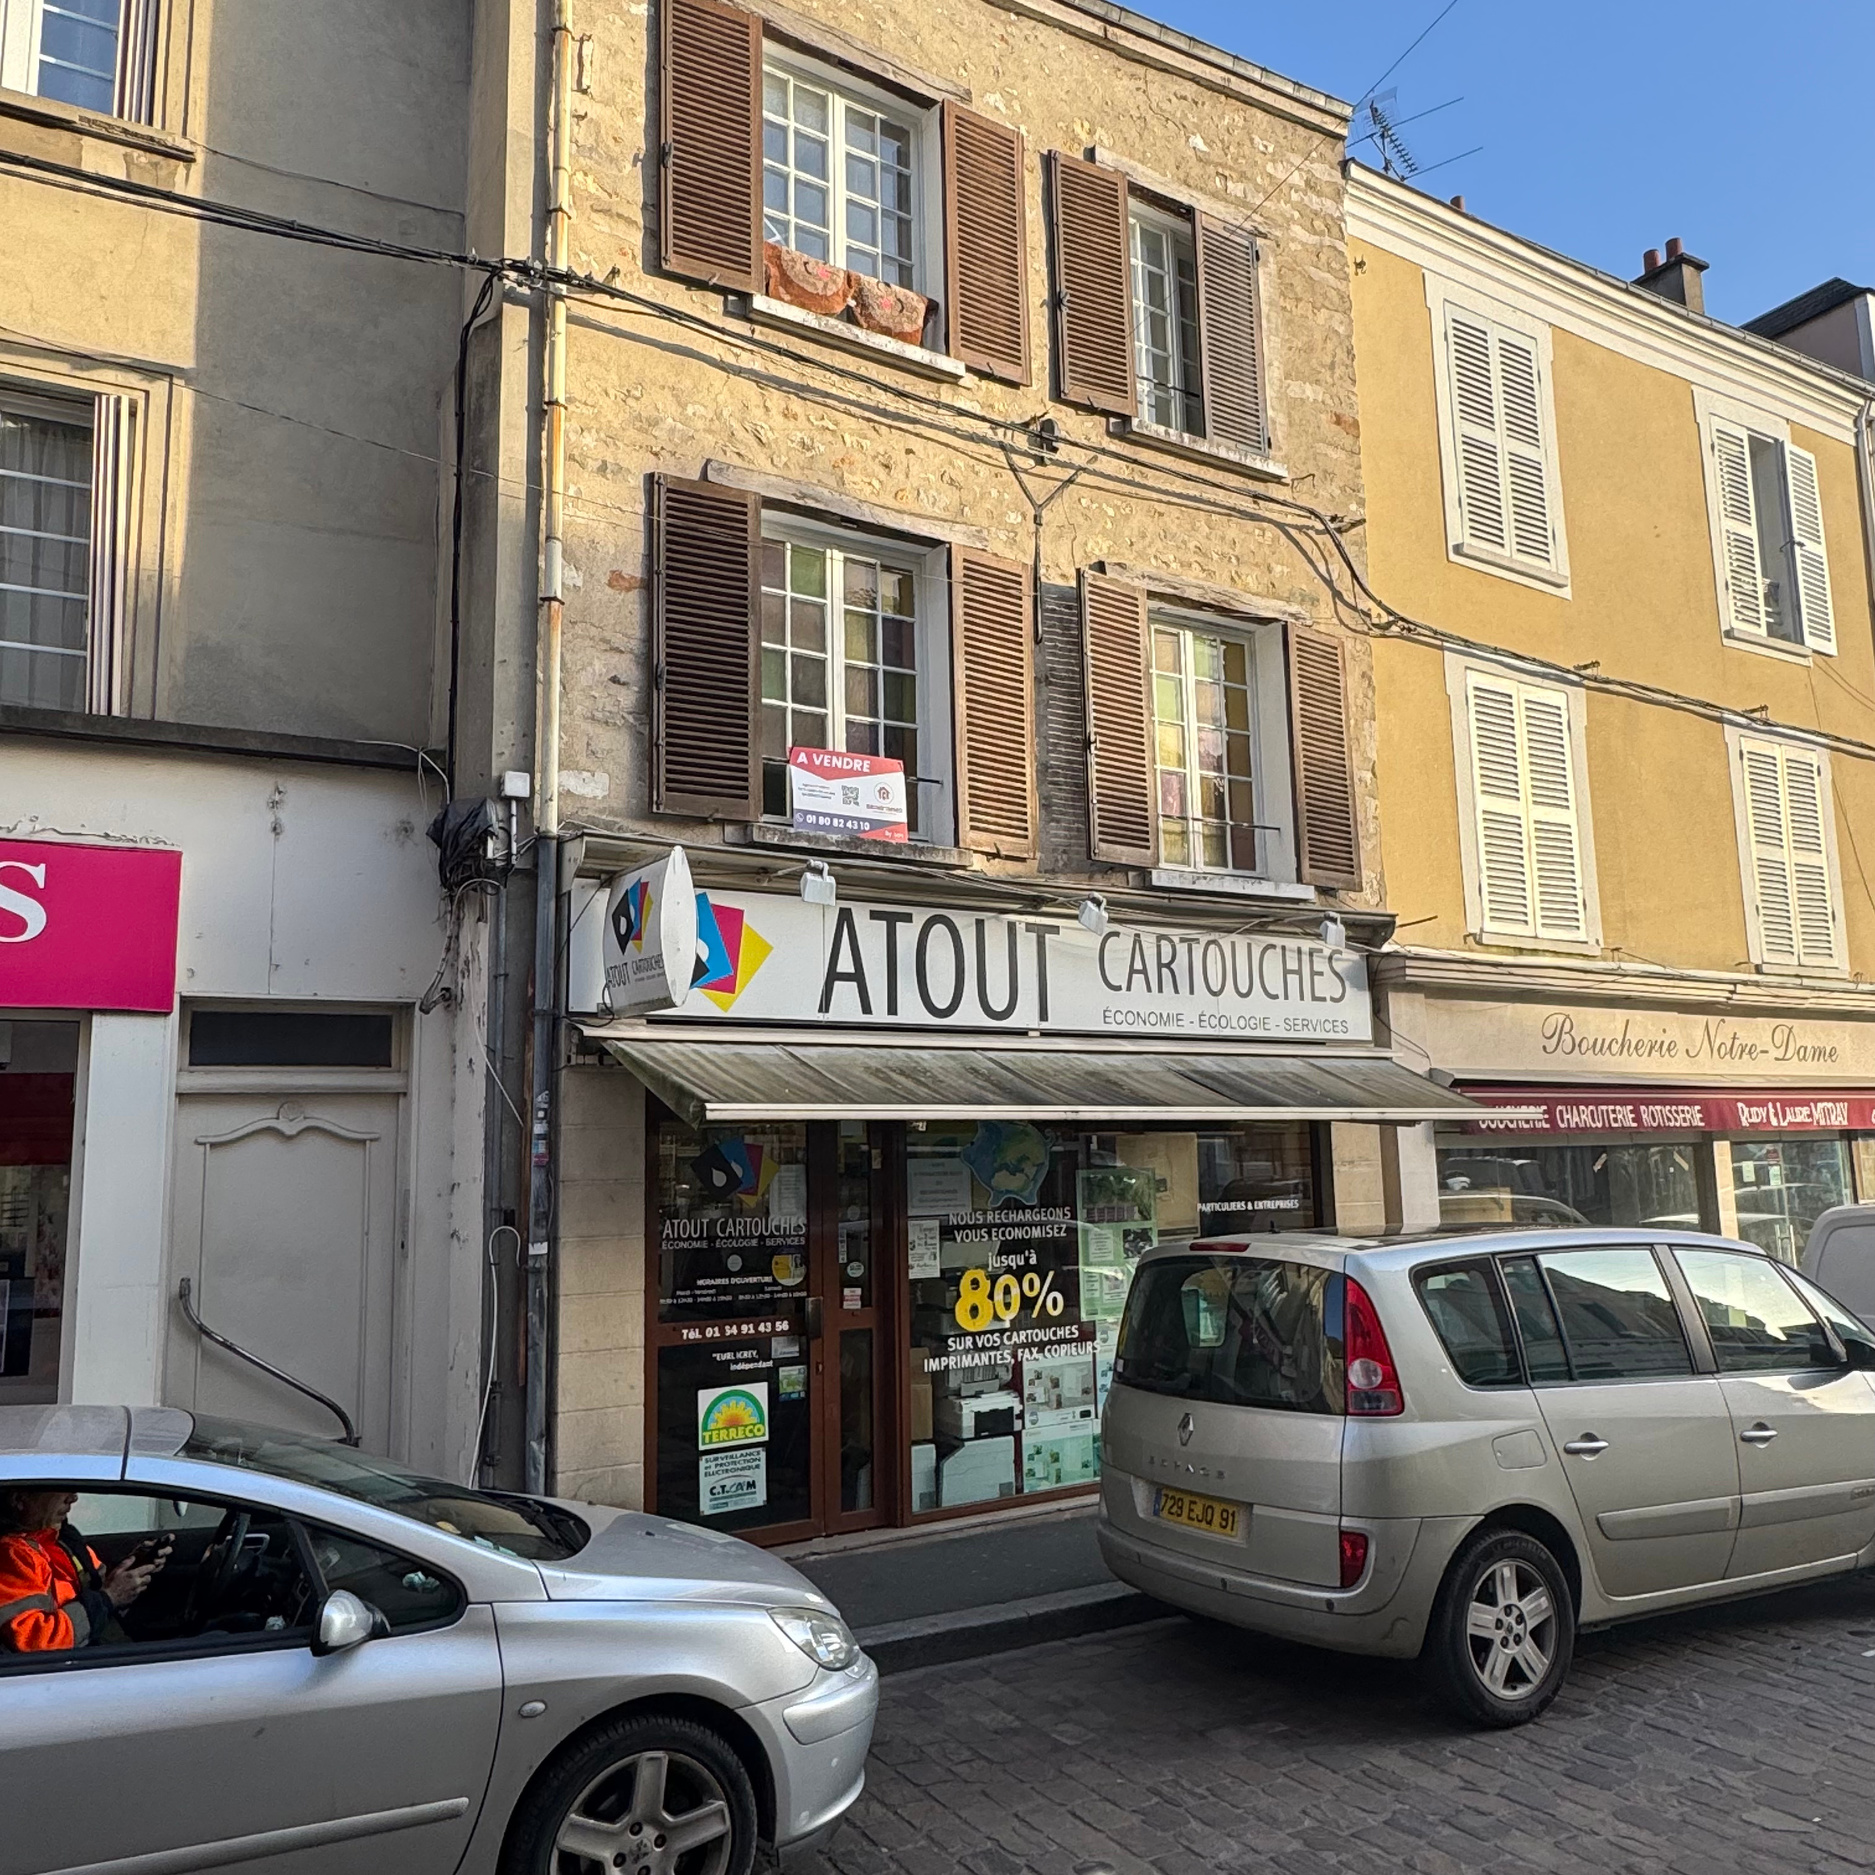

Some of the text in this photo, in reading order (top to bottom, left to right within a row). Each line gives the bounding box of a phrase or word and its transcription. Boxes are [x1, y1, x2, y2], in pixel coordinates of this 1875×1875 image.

[797, 752, 871, 773] A VENDRE
[806, 814, 817, 825] 01
[818, 816, 831, 826] 80
[846, 820, 859, 830] 43
[860, 821, 871, 831] 10
[607, 962, 631, 988] ATOUT
[818, 906, 1060, 1023] ATOUT
[1098, 931, 1347, 1004] CARTOUCHES
[1102, 1006, 1185, 1029] ÉCONOMIE
[1199, 1010, 1271, 1031] ÉCOLOGIE
[1283, 1017, 1349, 1035] SERVICES
[1541, 1012, 1839, 1063] Boucherie Notre-Dame
[1556, 1105, 1638, 1128] CHARCUTERIE
[1640, 1105, 1705, 1127] ROTISSERIE
[950, 1207, 1071, 1225] NOUS RECHARGEONS
[663, 1217, 806, 1239] ATOUT CARTOUCHES
[954, 1224, 1067, 1243] VOUS ECONOMISEZ
[716, 1237, 758, 1248] ÉCOLOGIE
[988, 1250, 1037, 1271] jusqu'à
[955, 1268, 1064, 1332] 80%
[705, 1326, 720, 1337] 01
[741, 1323, 755, 1334] 91
[758, 1321, 771, 1333] 43
[775, 1320, 789, 1331] 56
[947, 1325, 1079, 1351] SUR VOS CARTOUCHES
[924, 1350, 1014, 1372] IMPRIMANTES,
[1044, 1341, 1101, 1358] COPIEURS
[702, 1423, 765, 1443] TERRECO
[704, 1450, 761, 1464] SURVEILLANCE
[714, 1457, 761, 1469] PROTECTION
[1160, 1493, 1236, 1532] 729 EJQ 91
